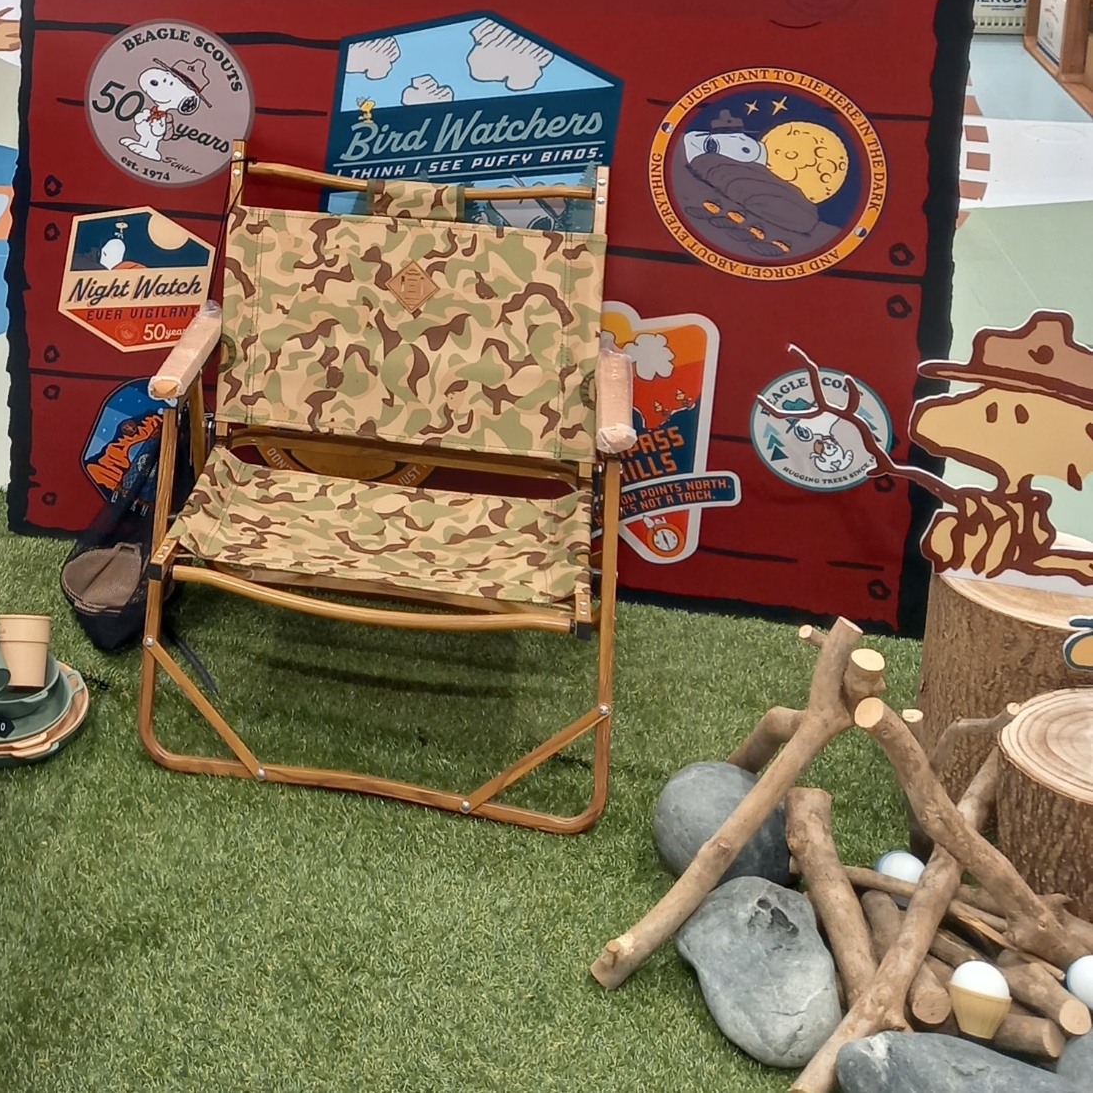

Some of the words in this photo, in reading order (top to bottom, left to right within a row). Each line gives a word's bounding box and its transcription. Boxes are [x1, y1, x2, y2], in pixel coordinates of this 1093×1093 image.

[122, 28, 191, 53] BEAGLE
[193, 35, 243, 93] SCOUTS
[721, 69, 770, 87] WANT
[773, 69, 795, 83] TO
[798, 73, 824, 93] LIE
[685, 78, 721, 106] JUST
[823, 87, 862, 121] HERE
[92, 80, 145, 122] 50
[171, 123, 230, 154] years
[856, 116, 873, 137] IN
[340, 117, 432, 161] Bird
[432, 107, 604, 153] Watchers
[350, 164, 407, 179] THINK
[414, 162, 422, 174] I
[428, 159, 465, 173] SEE
[471, 152, 533, 169] PUFFY
[540, 147, 605, 163] BIRDS.
[867, 137, 885, 170] THE
[121, 156, 139, 172] est.
[142, 167, 171, 182] 1974
[651, 152, 691, 242] EVERYTHING
[869, 172, 886, 213] DARK
[689, 239, 742, 274] ABOUT
[740, 260, 807, 279] FORGET
[808, 249, 840, 272] AND
[67, 277, 131, 307] Night
[132, 274, 203, 300] Watch
[86, 308, 124, 321] EVER
[782, 465, 820, 484] HUGGING
[821, 475, 849, 485] TREES
[639, 482, 683, 499] POINTS
[640, 495, 663, 510] NOT
[666, 495, 675, 505] A
